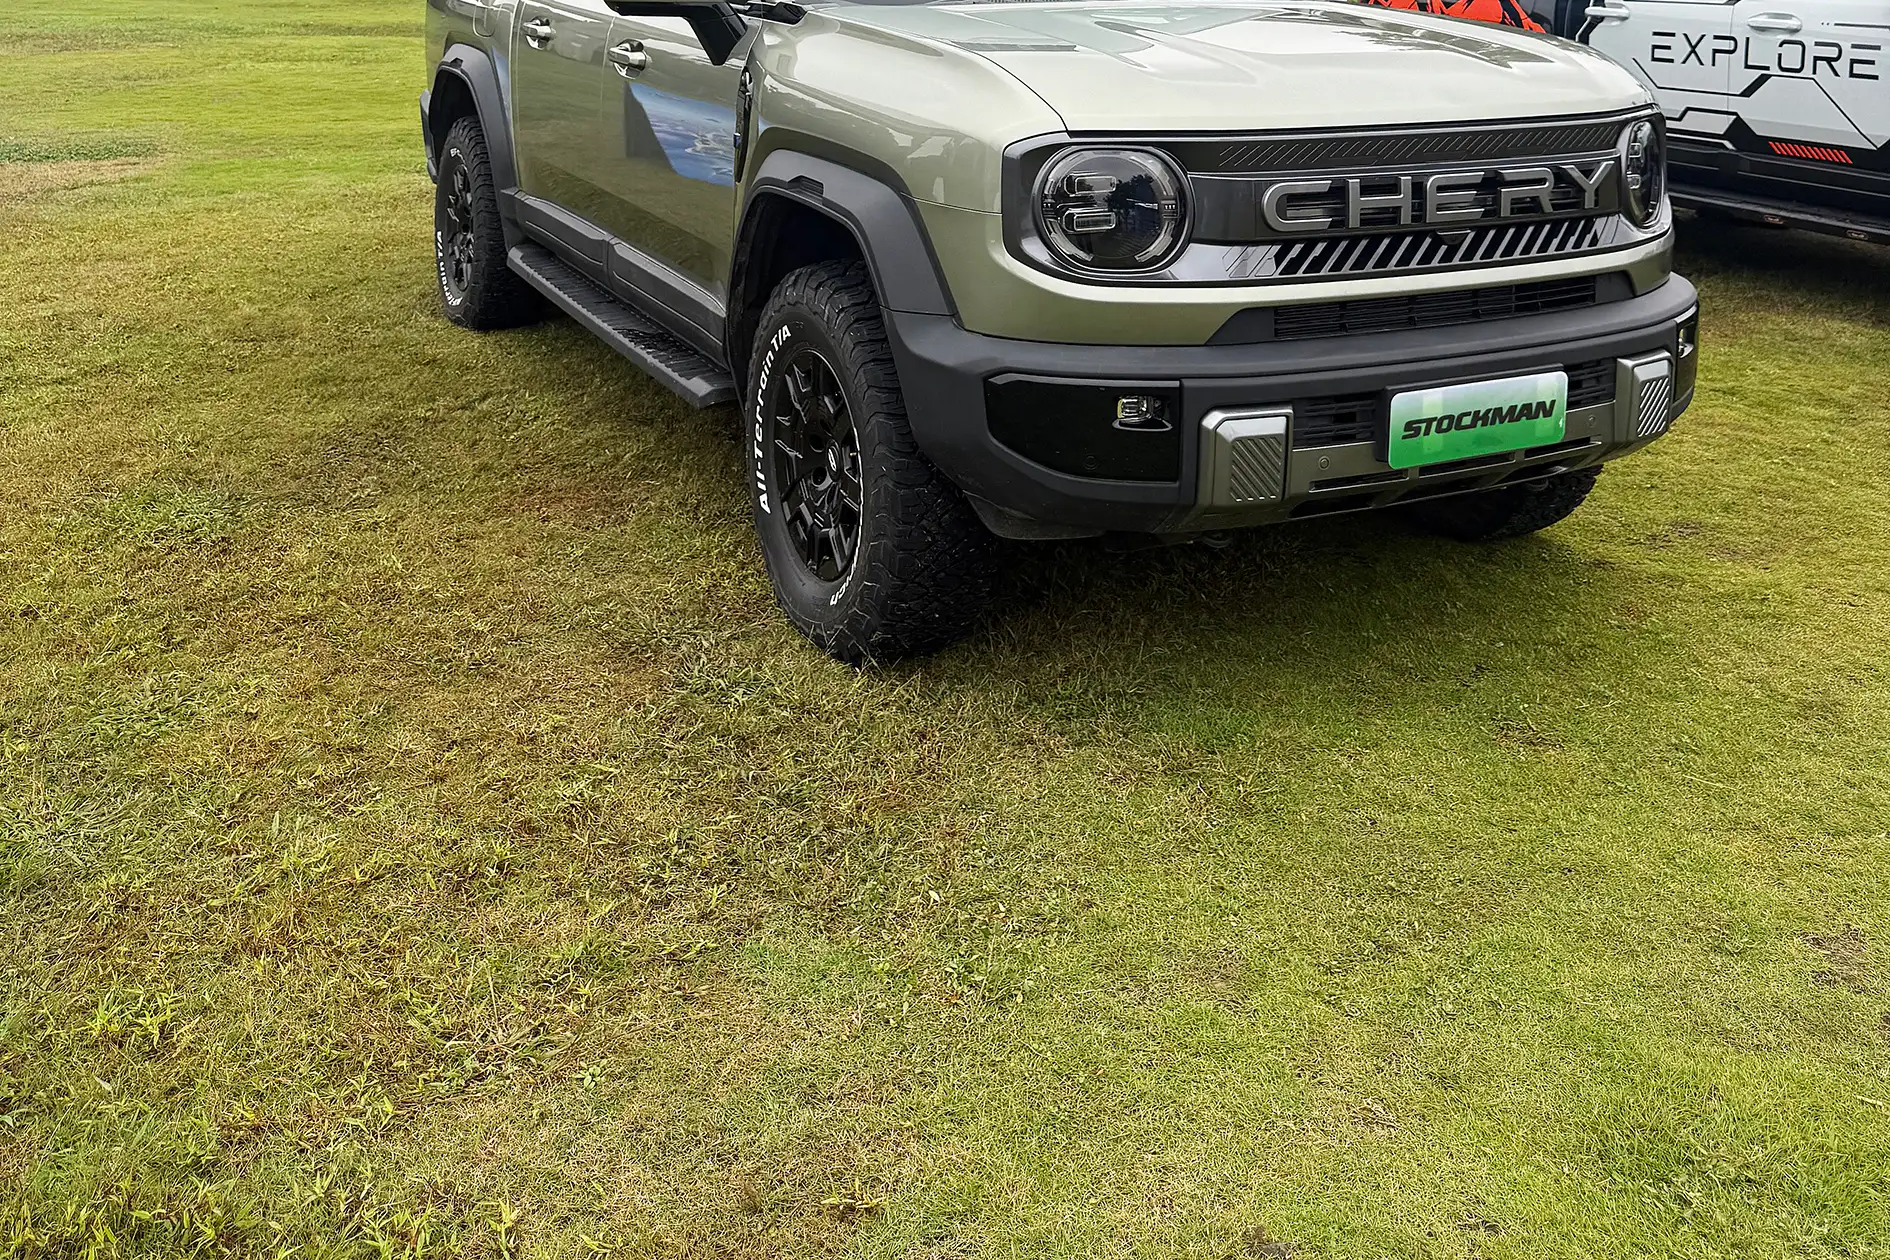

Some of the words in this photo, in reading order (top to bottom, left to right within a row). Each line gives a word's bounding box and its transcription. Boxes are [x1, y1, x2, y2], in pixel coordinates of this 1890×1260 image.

[1650, 30, 1882, 81] EXPLORE
[1262, 160, 1615, 233] CHERY
[754, 350, 775, 515] All-Terrain
[770, 324, 792, 352] T/A
[1400, 399, 1557, 440] STOCKMAN
